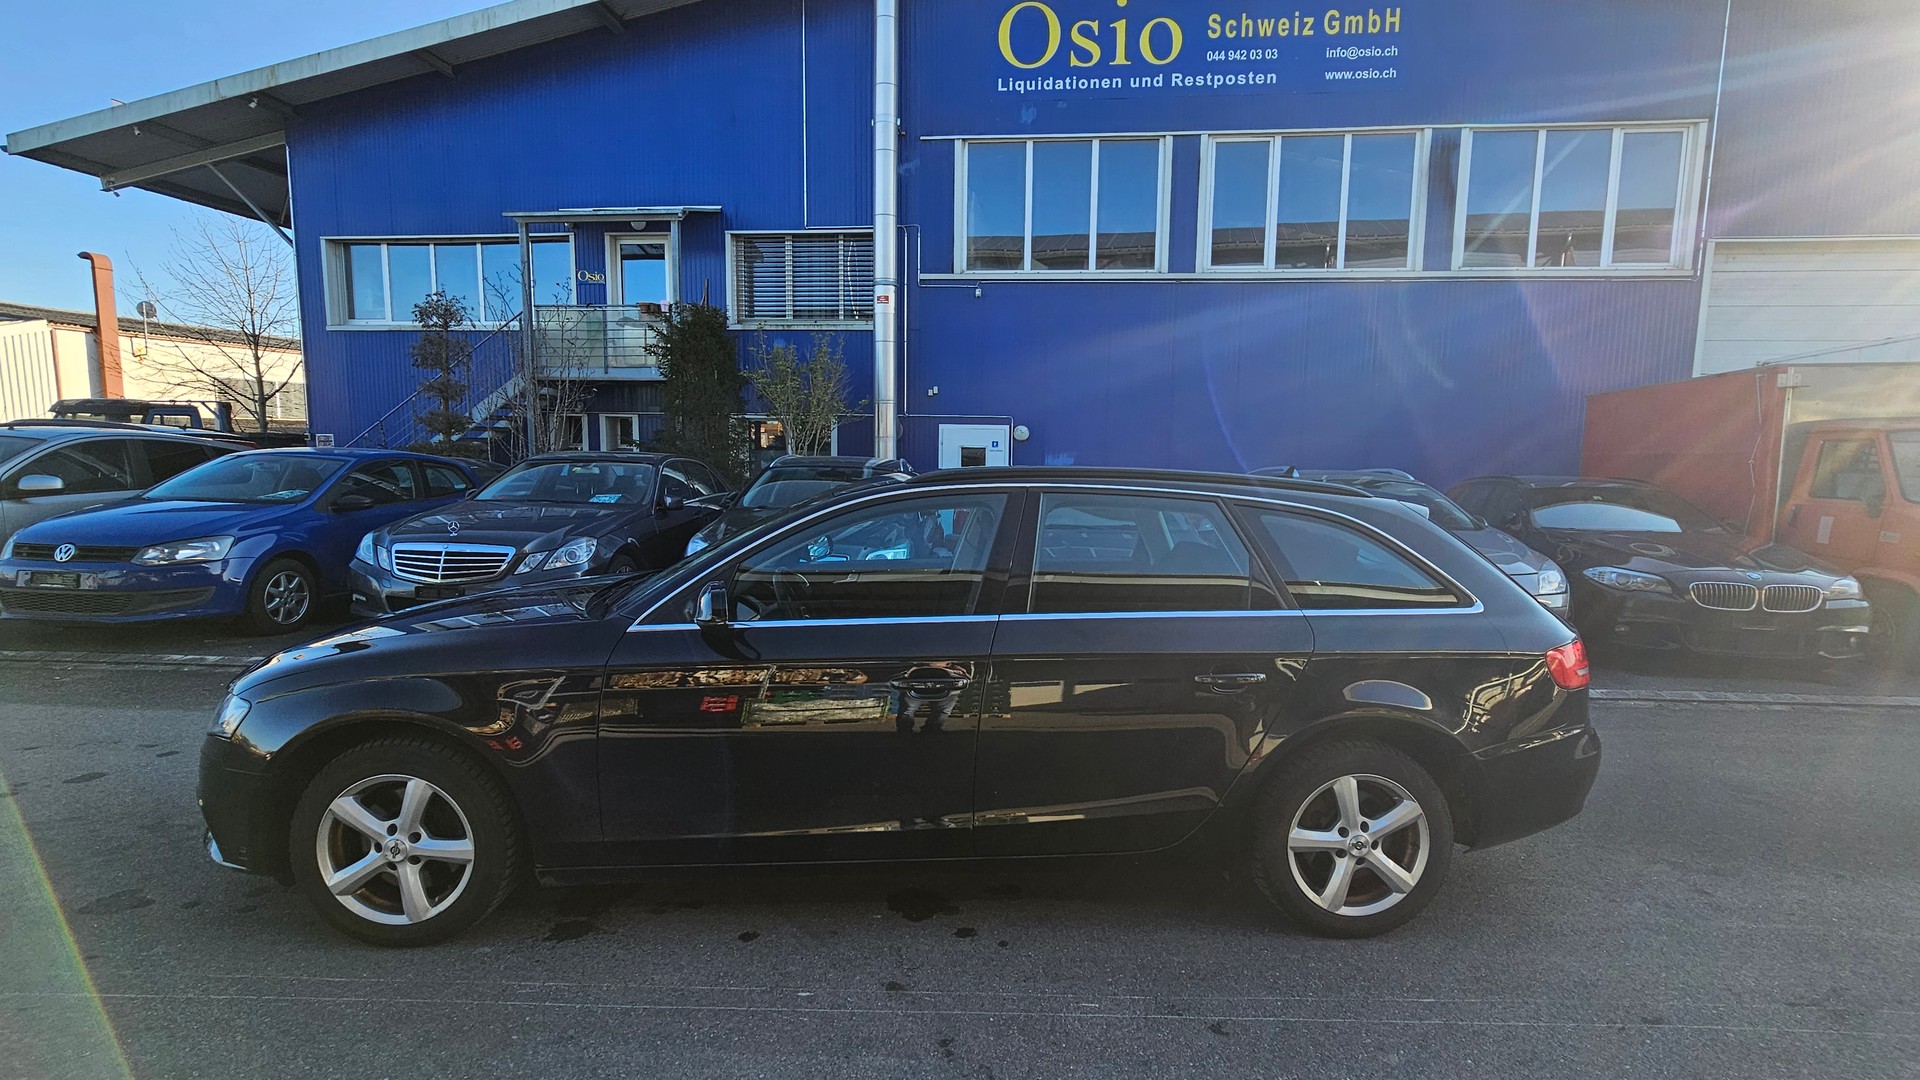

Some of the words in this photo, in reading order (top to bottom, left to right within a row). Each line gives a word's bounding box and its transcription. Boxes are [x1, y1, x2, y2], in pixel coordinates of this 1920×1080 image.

[1207, 11, 1315, 39] Schweiz
[1323, 7, 1401, 35] GmbH
[998, 0, 1183, 69] Osio
[1206, 50, 1225, 62] 044
[1227, 49, 1247, 61] 942
[1249, 49, 1263, 61] 03
[1265, 48, 1279, 60] 03
[1325, 46, 1399, 60] info@osio.ch
[1324, 67, 1398, 80] www.osio.ch
[997, 76, 1122, 94] Liquidationen
[1129, 73, 1163, 88] und
[1170, 71, 1278, 89] Restposten
[577, 269, 605, 281] Osio
